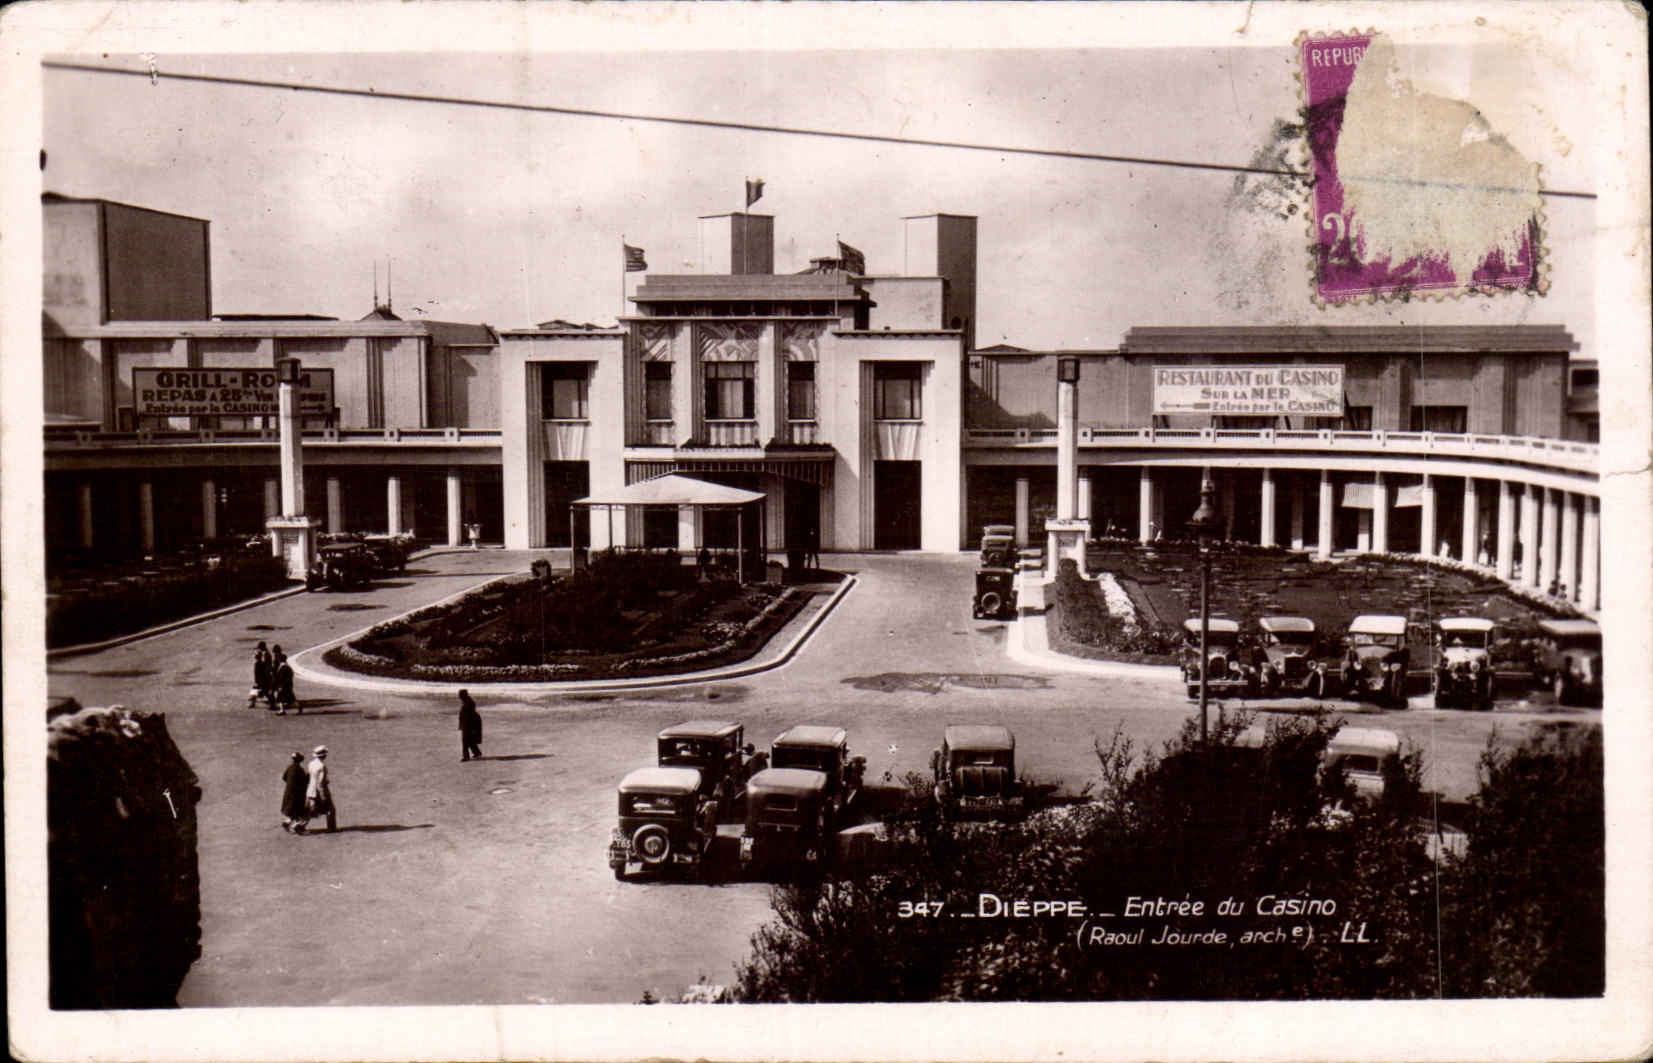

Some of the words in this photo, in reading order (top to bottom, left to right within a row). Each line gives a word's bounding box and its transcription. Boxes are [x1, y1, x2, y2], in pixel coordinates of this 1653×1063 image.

[1157, 369, 1253, 386] RESTAURANT
[1277, 369, 1338, 386] CASINO
[142, 389, 206, 402] REPAS
[1251, 387, 1291, 400] MER
[146, 403, 186, 413] Entrée
[189, 405, 208, 415] par
[210, 403, 221, 413] le
[223, 402, 269, 413] CASINO
[1212, 401, 1250, 411] Entrée
[1252, 403, 1271, 412] par
[1273, 401, 1285, 411] le
